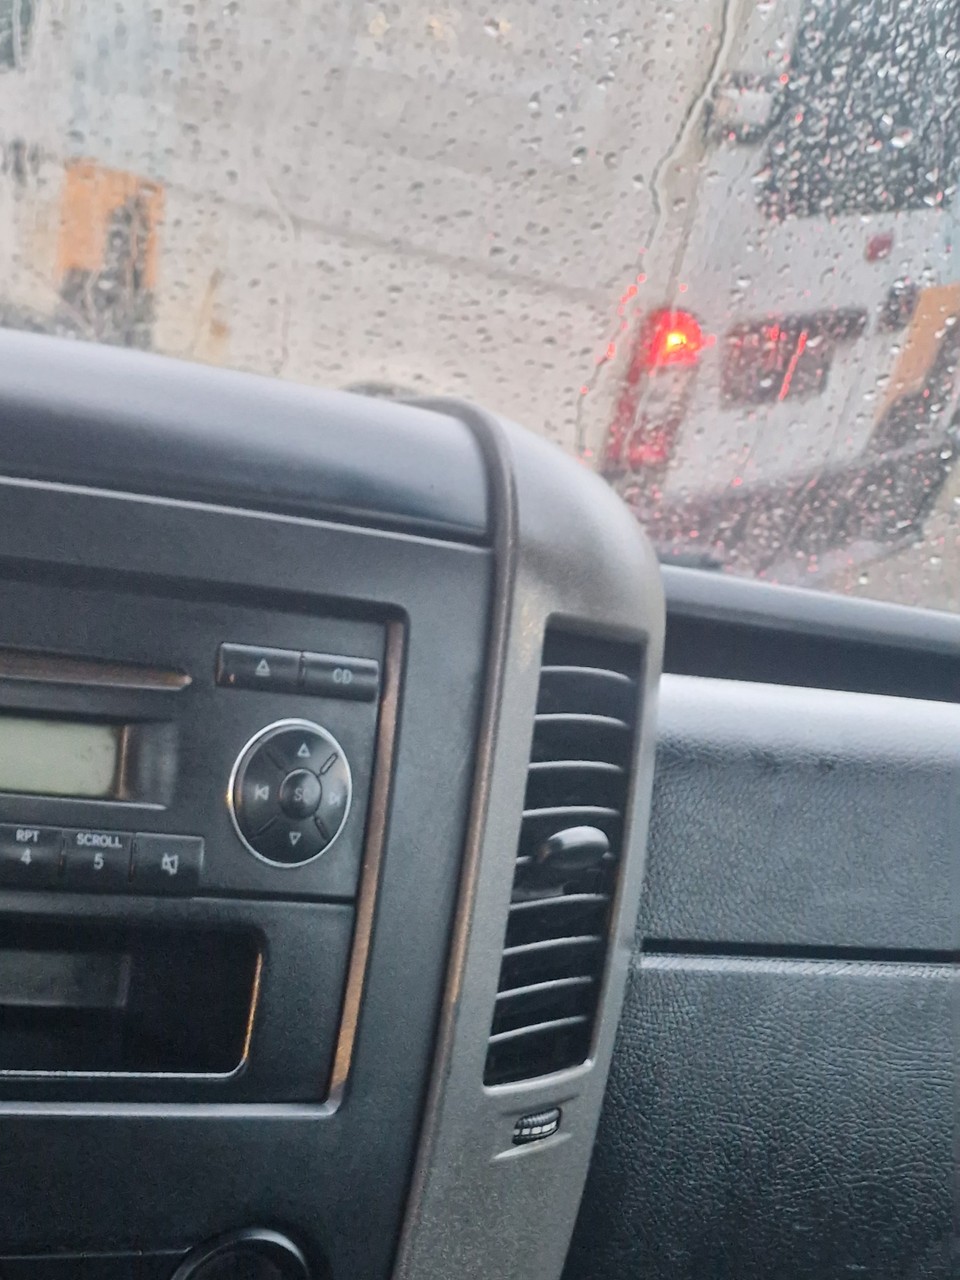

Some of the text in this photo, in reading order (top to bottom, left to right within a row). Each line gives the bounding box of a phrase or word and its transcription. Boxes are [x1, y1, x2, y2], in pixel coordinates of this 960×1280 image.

[332, 668, 353, 684] CD
[16, 829, 40, 843] RPT
[76, 832, 123, 849] SCROLL
[20, 848, 32, 865] 4
[93, 853, 104, 870] 5
